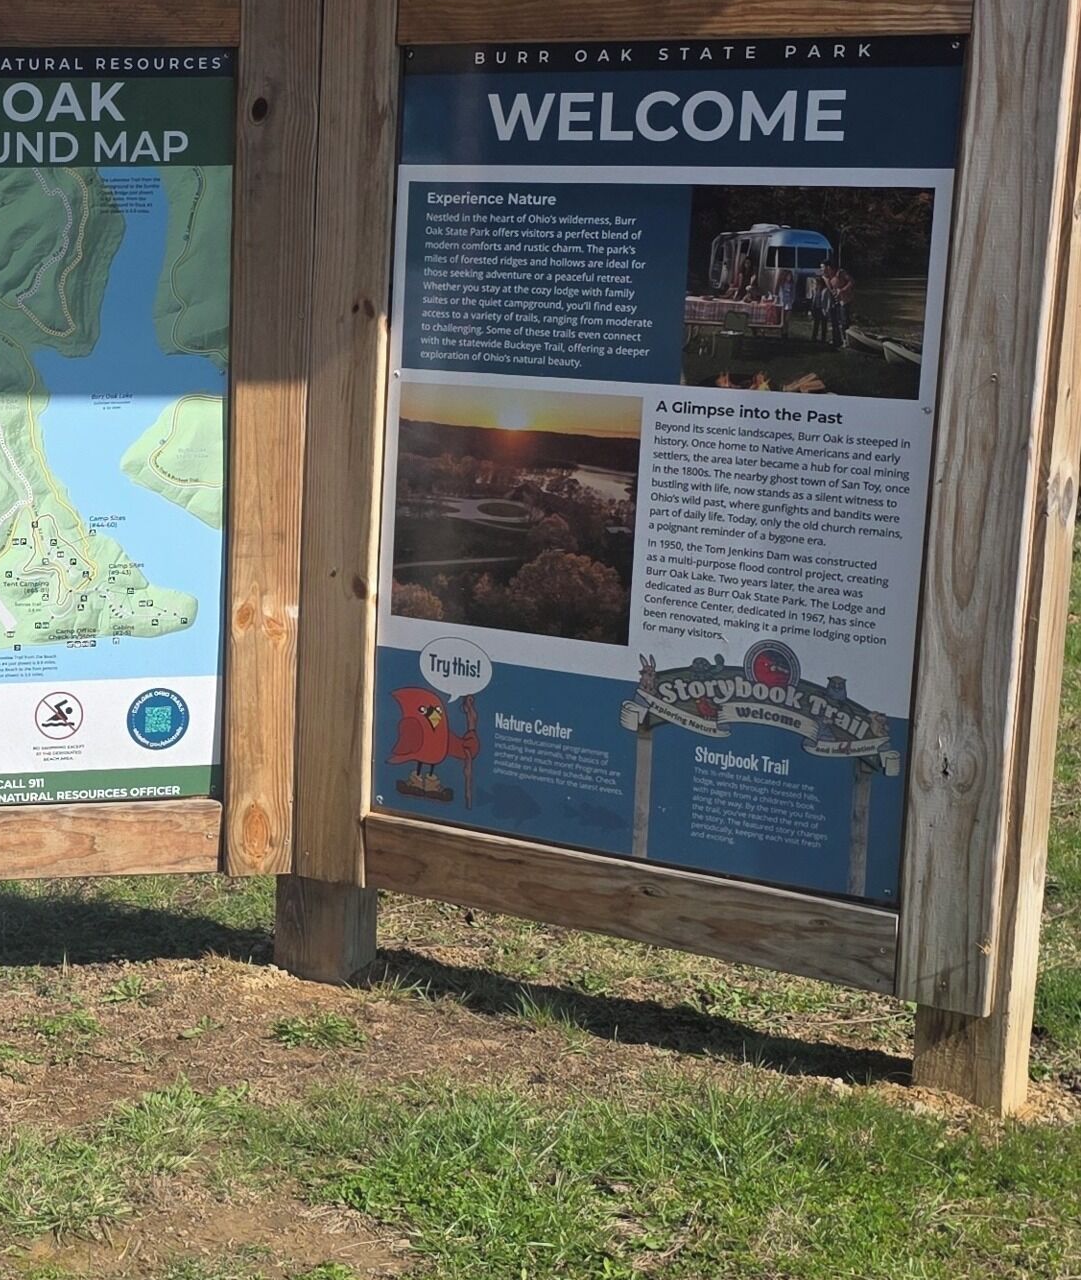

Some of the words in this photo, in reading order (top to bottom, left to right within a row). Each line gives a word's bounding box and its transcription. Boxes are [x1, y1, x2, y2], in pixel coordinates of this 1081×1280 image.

[95, 56, 222, 70] RESOURCES
[474, 50, 549, 64] BURR
[574, 48, 632, 62] OAK
[658, 46, 756, 61] STATE
[784, 43, 870, 58] PARK
[2, 81, 125, 122] OAK
[487, 89, 846, 142] WELCOME
[94, 130, 188, 162] MAP
[427, 191, 504, 207] Experience
[507, 192, 557, 205] Nature
[425, 212, 460, 222] Nestled
[461, 212, 470, 222] in
[472, 213, 487, 223] the
[489, 213, 514, 223] heart
[516, 213, 527, 223] of
[558, 214, 612, 226] wilderness,
[614, 215, 637, 225] Burr
[424, 225, 443, 235] Oak
[444, 226, 468, 236] State
[469, 227, 490, 236] Park
[491, 227, 519, 237] offers
[520, 228, 555, 238] visitors
[556, 230, 562, 238] a
[564, 228, 599, 241] perfect
[601, 229, 629, 240] blend
[630, 229, 642, 240] of
[655, 400, 667, 413] A
[671, 400, 735, 418] Glimpse
[739, 404, 770, 419] into
[774, 407, 802, 421] the
[807, 409, 843, 424] Past
[654, 421, 690, 433] Beyond
[692, 423, 704, 434] its
[706, 426, 736, 436] scenic
[737, 426, 795, 441] landscapes,
[797, 431, 821, 442] Burr
[822, 433, 843, 444] Oak
[845, 434, 854, 445] is
[855, 437, 898, 449] steeped
[900, 438, 910, 448] in
[653, 434, 689, 449] history.
[690, 438, 716, 449] Once
[717, 439, 747, 451] home
[748, 443, 759, 452] to
[761, 443, 794, 455] Native
[794, 446, 850, 459] Americans
[851, 450, 872, 461] and
[874, 452, 901, 465] early
[642, 620, 657, 631] for
[658, 625, 686, 637] many
[687, 627, 726, 642] visitors.
[428, 652, 450, 678] Try
[451, 656, 480, 678] this!
[658, 676, 803, 709] Storybook
[808, 695, 870, 740] Trail
[736, 706, 802, 729] Welcome
[495, 712, 532, 733] Nature
[533, 719, 573, 740] Center
[694, 745, 759, 771] Storybook
[761, 755, 789, 775] Trail
[28, 777, 44, 788] 911
[56, 787, 127, 801] RESOURCES
[129, 785, 180, 797] OFFICER
